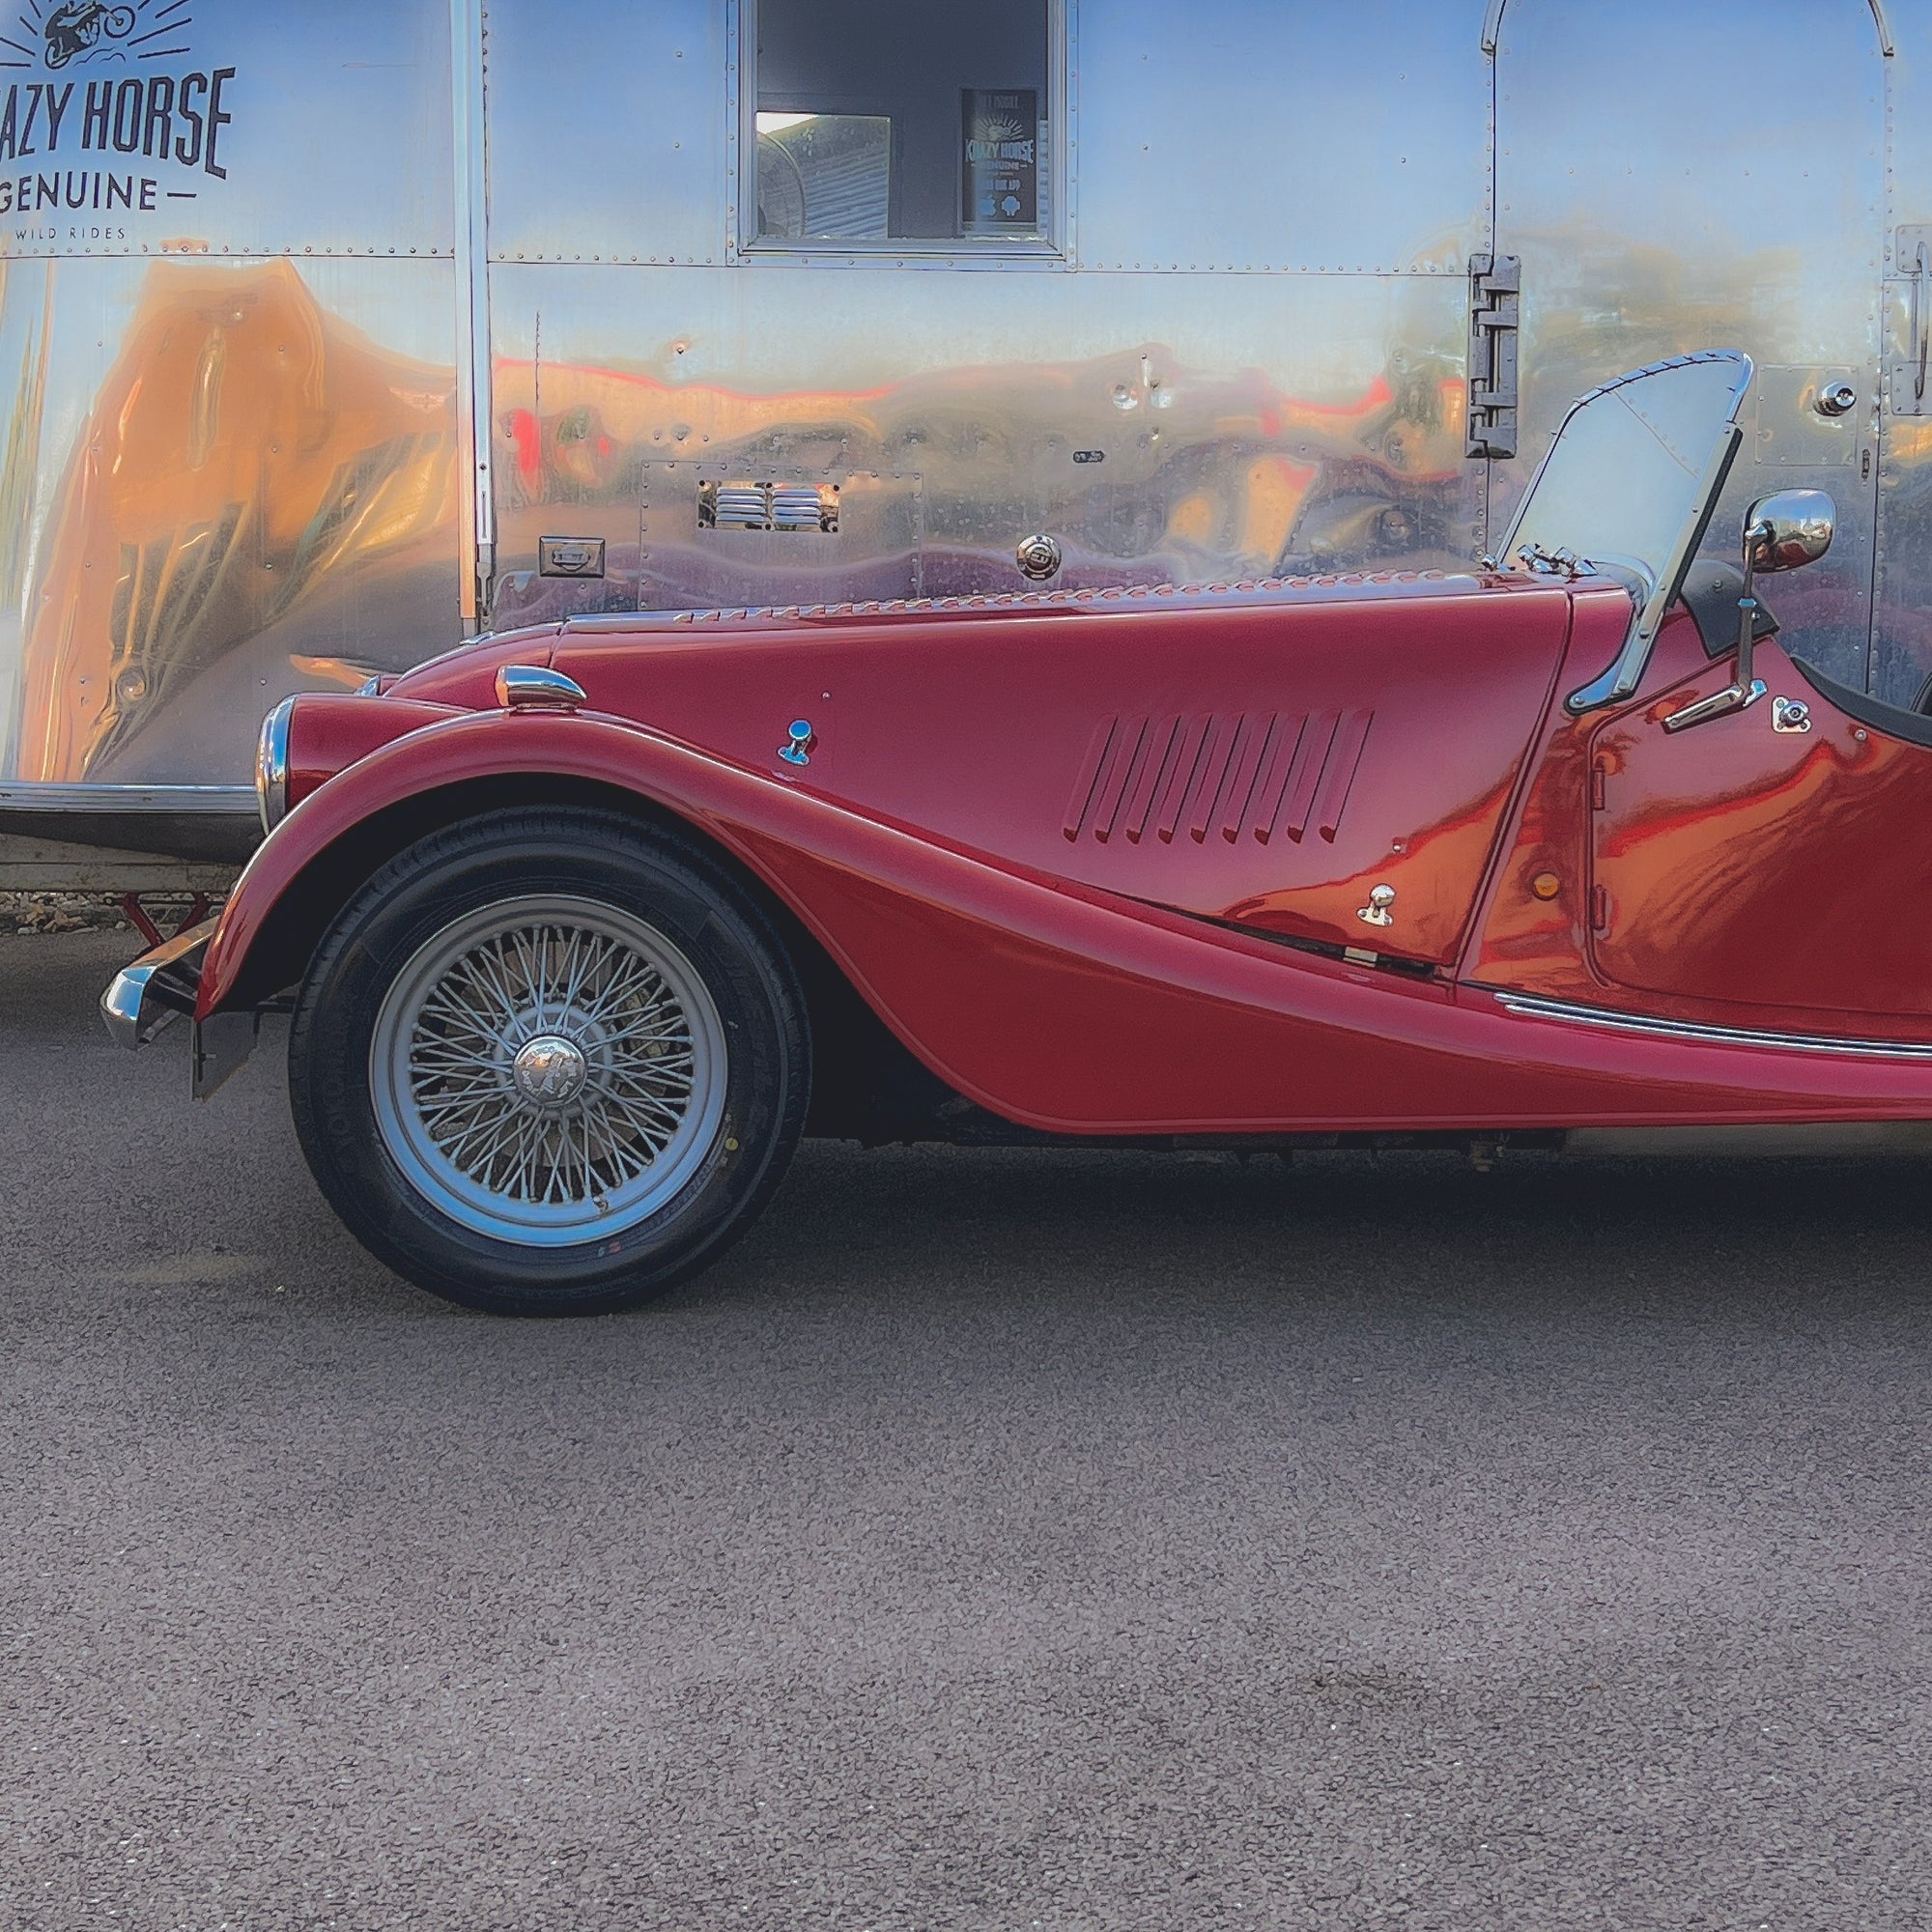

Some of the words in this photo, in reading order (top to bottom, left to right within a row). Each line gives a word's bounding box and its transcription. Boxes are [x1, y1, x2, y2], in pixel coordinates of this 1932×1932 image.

[81, 67, 236, 181] HORSE
[978, 160, 1019, 171] ENUINE
[14, 227, 56, 240] WILD
[70, 227, 125, 240] RIDES
